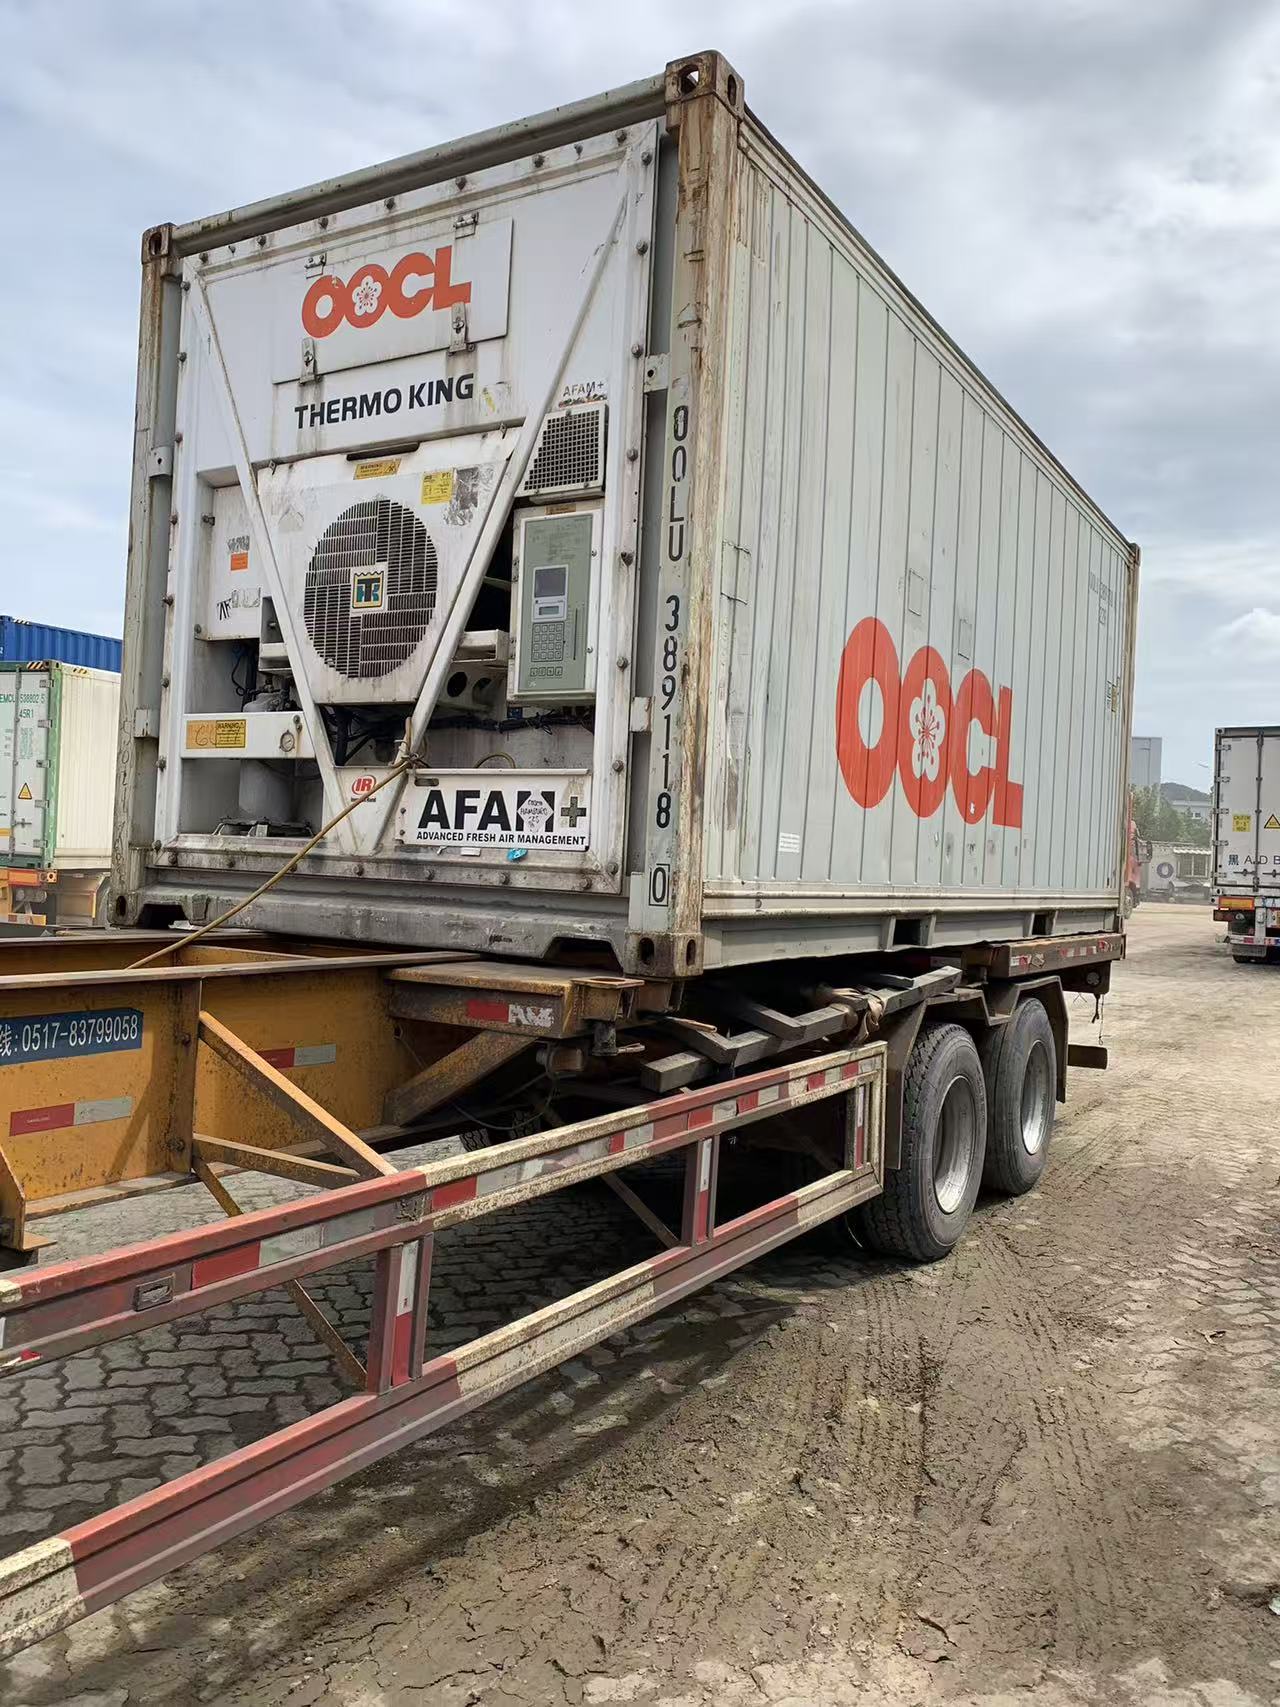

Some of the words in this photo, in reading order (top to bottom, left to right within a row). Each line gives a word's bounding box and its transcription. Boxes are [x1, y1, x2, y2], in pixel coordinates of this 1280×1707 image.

[302, 245, 472, 338] OOCL
[294, 388, 402, 430] THERMO
[408, 373, 475, 409] KING
[667, 405, 689, 562] OOLU
[19, 708, 34, 719] 45R1
[656, 594, 680, 829] 389118
[835, 616, 1024, 829] OOCL
[355, 778, 373, 792] IR
[416, 831, 463, 842] ADVANCED
[466, 833, 496, 843] FRESH
[499, 834, 515, 843] AIR
[517, 834, 587, 846] MANAGEMENT
[651, 865, 668, 904] 0
